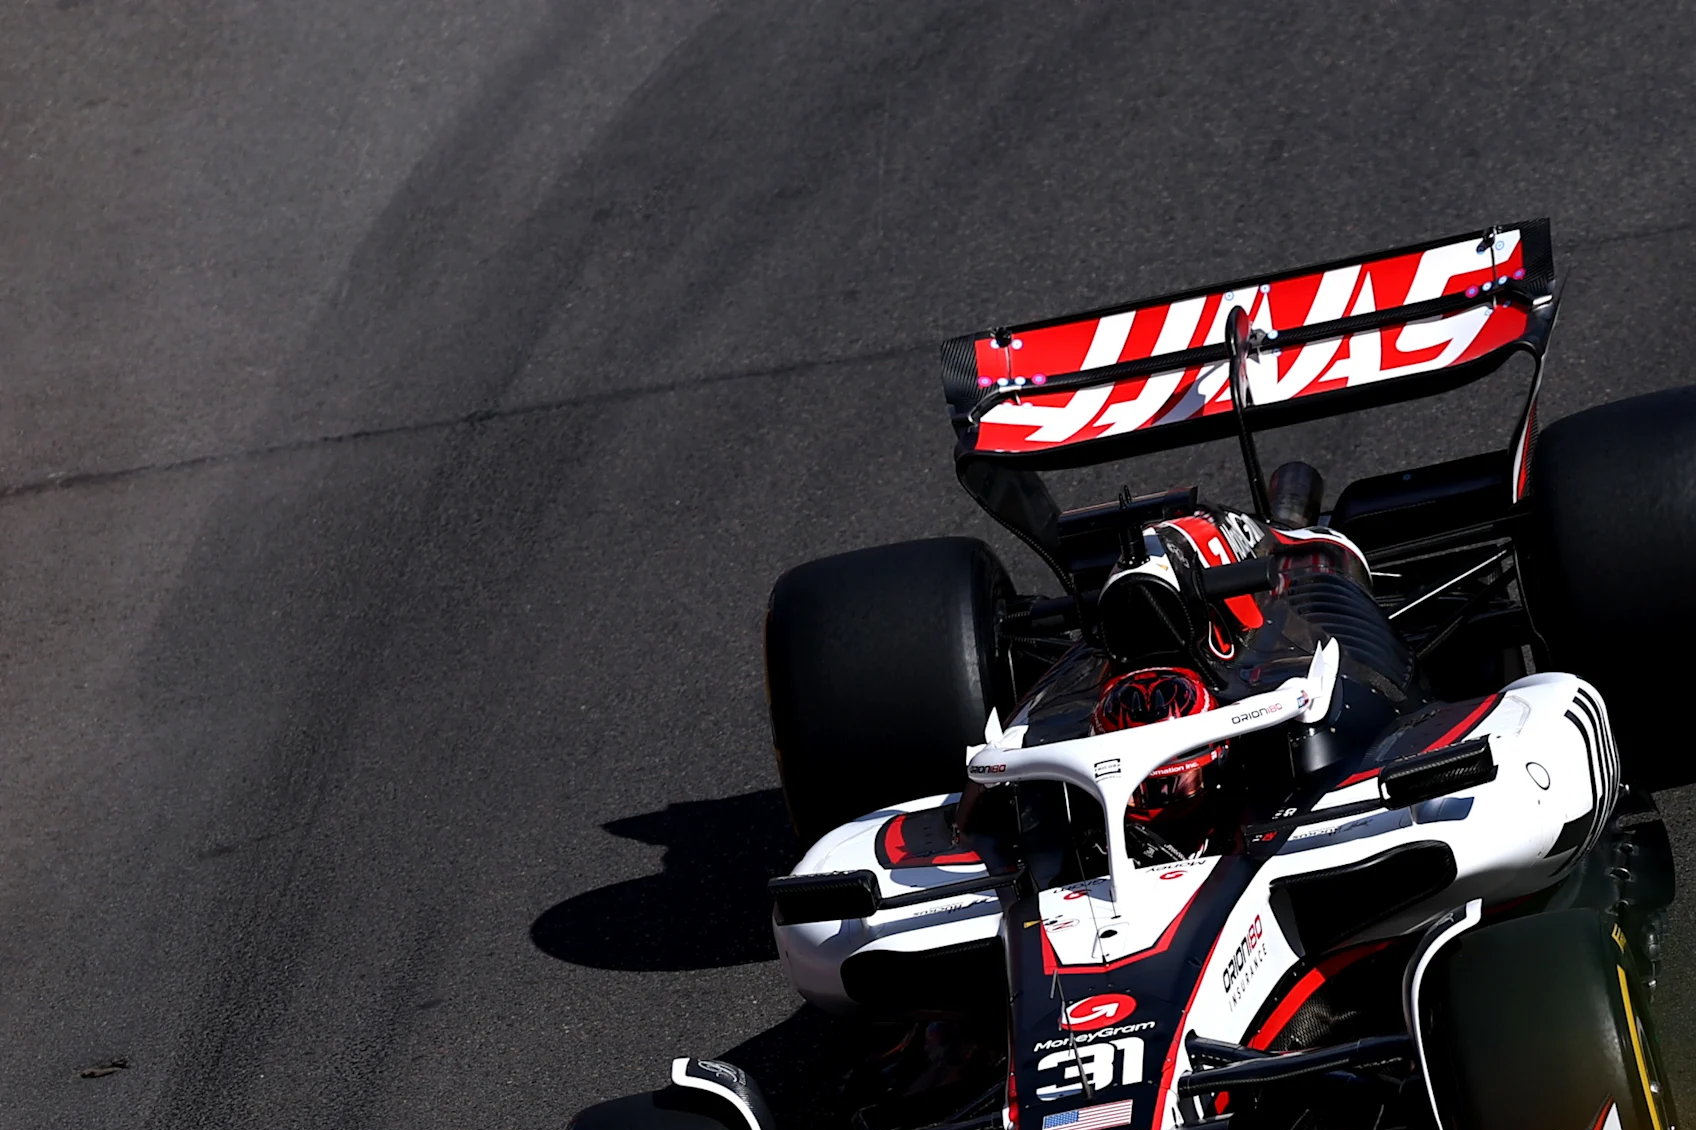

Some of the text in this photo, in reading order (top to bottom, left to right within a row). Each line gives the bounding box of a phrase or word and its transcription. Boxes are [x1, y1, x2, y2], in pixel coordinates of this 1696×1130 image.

[980, 229, 1521, 441] HAAS
[1150, 765, 1185, 776] omation
[1033, 1021, 1156, 1052] MoneyGram
[1036, 1036, 1145, 1101] 31
